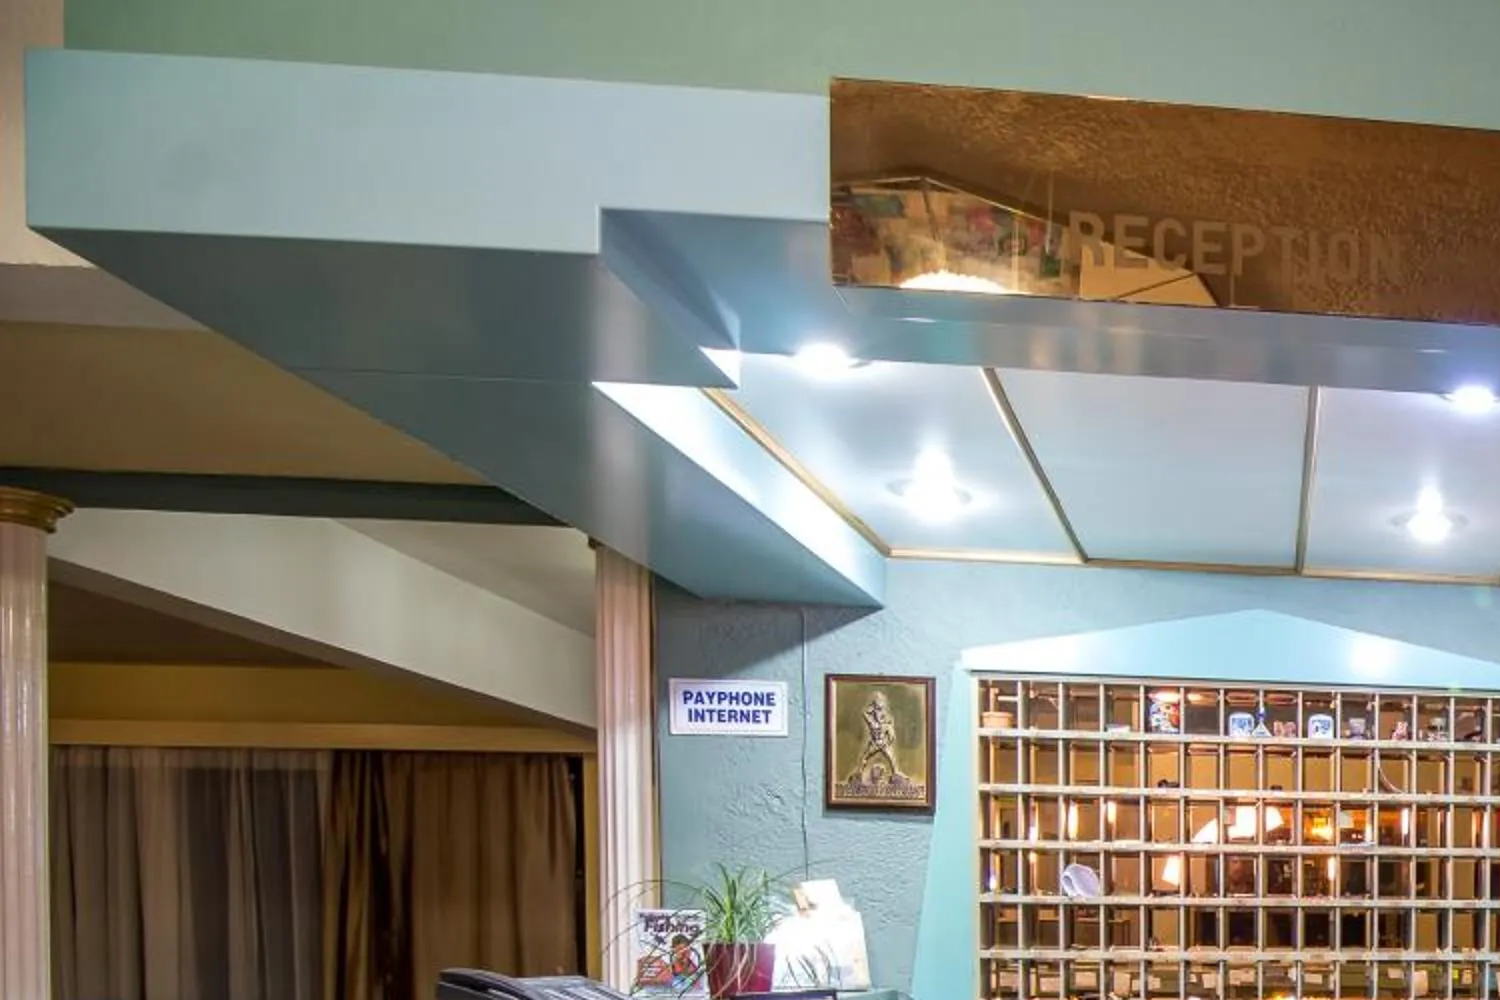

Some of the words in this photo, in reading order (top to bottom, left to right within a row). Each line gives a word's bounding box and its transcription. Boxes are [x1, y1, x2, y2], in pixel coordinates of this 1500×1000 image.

[1067, 209, 1406, 289] RECEPTION
[682, 690, 777, 707] PAYPHONE
[687, 708, 772, 724] INTERNET
